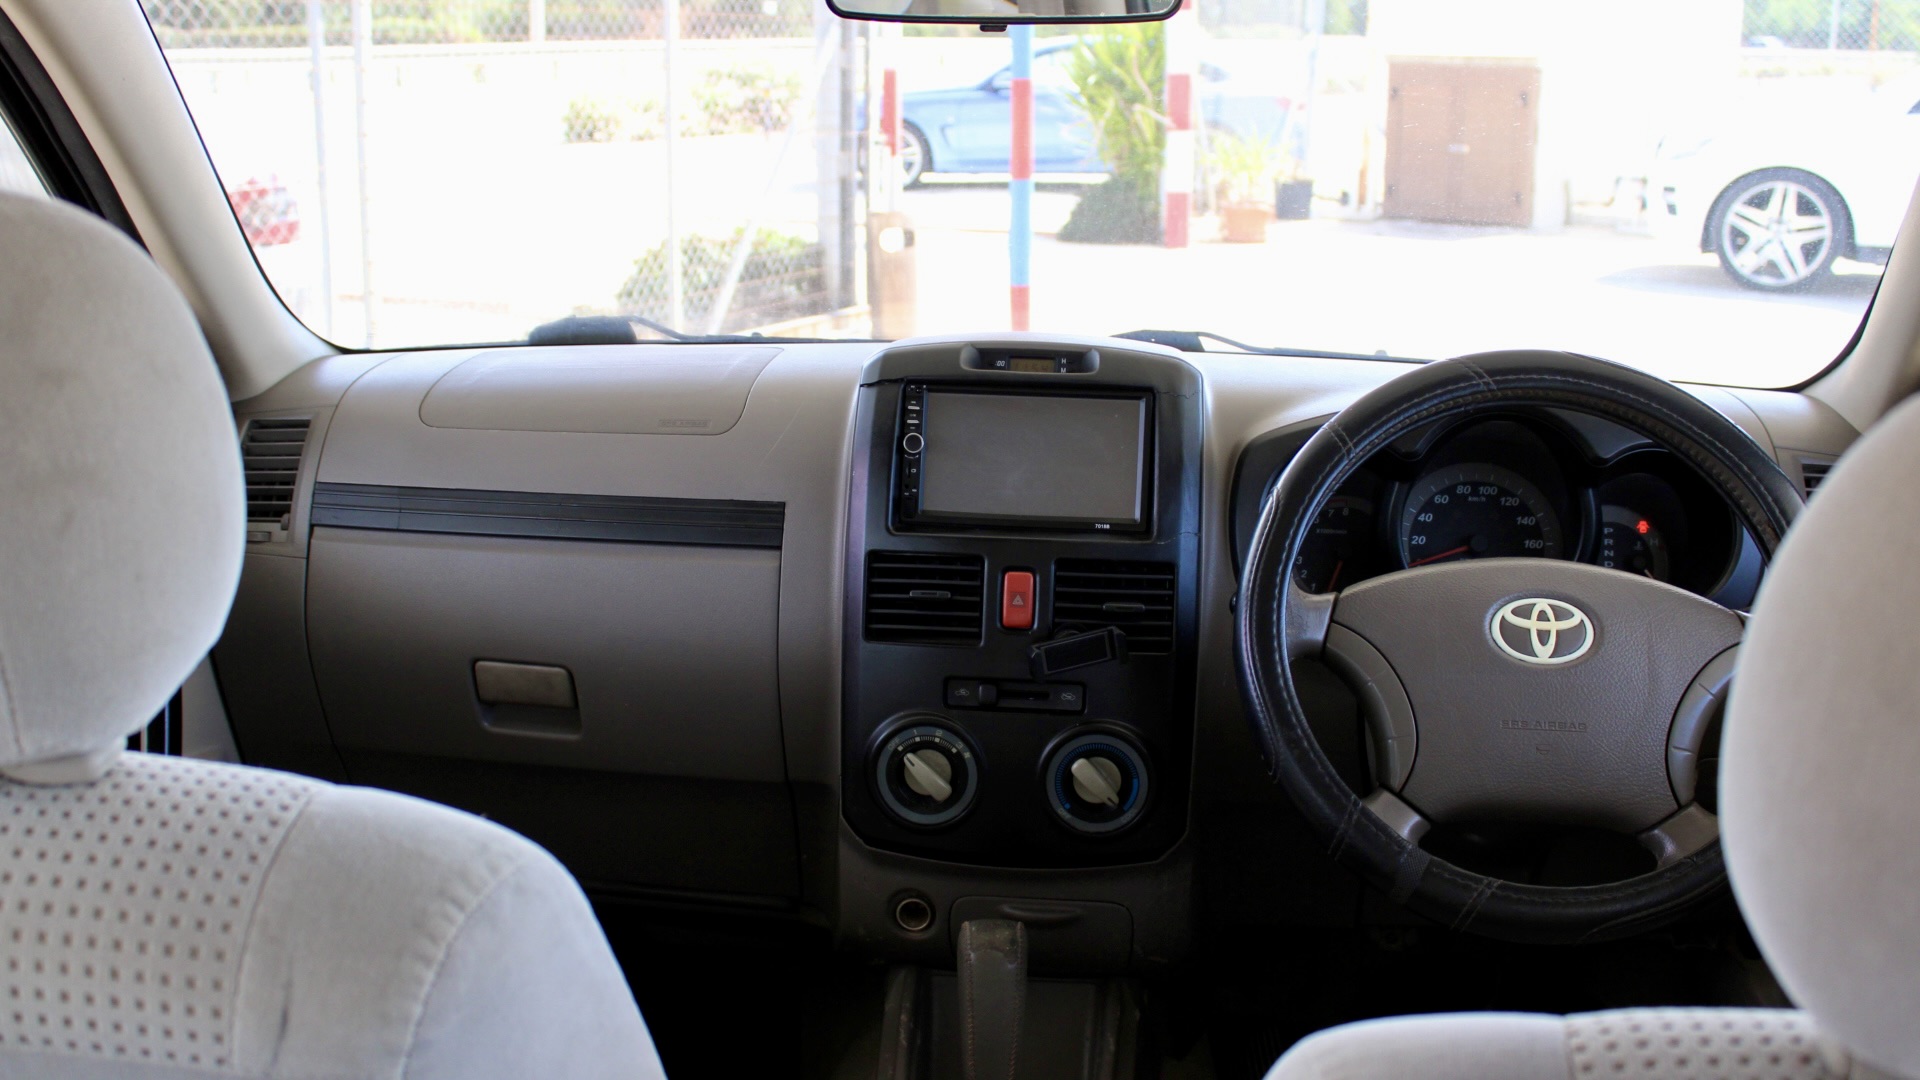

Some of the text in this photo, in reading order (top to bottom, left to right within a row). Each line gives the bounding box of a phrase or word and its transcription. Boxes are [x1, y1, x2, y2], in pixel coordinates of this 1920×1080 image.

[1456, 485, 1498, 496] 80 100
[1434, 494, 1450, 504] 60
[1499, 496, 1520, 507] 120
[1418, 513, 1434, 522] 40
[1516, 515, 1536, 526] 140
[1604, 527, 1614, 535] P
[1411, 535, 1427, 545] 20
[1523, 539, 1544, 549] 160
[1604, 538, 1614, 546] R
[1604, 549, 1614, 557] N
[1501, 719, 1587, 731] SRS AIRBAG
